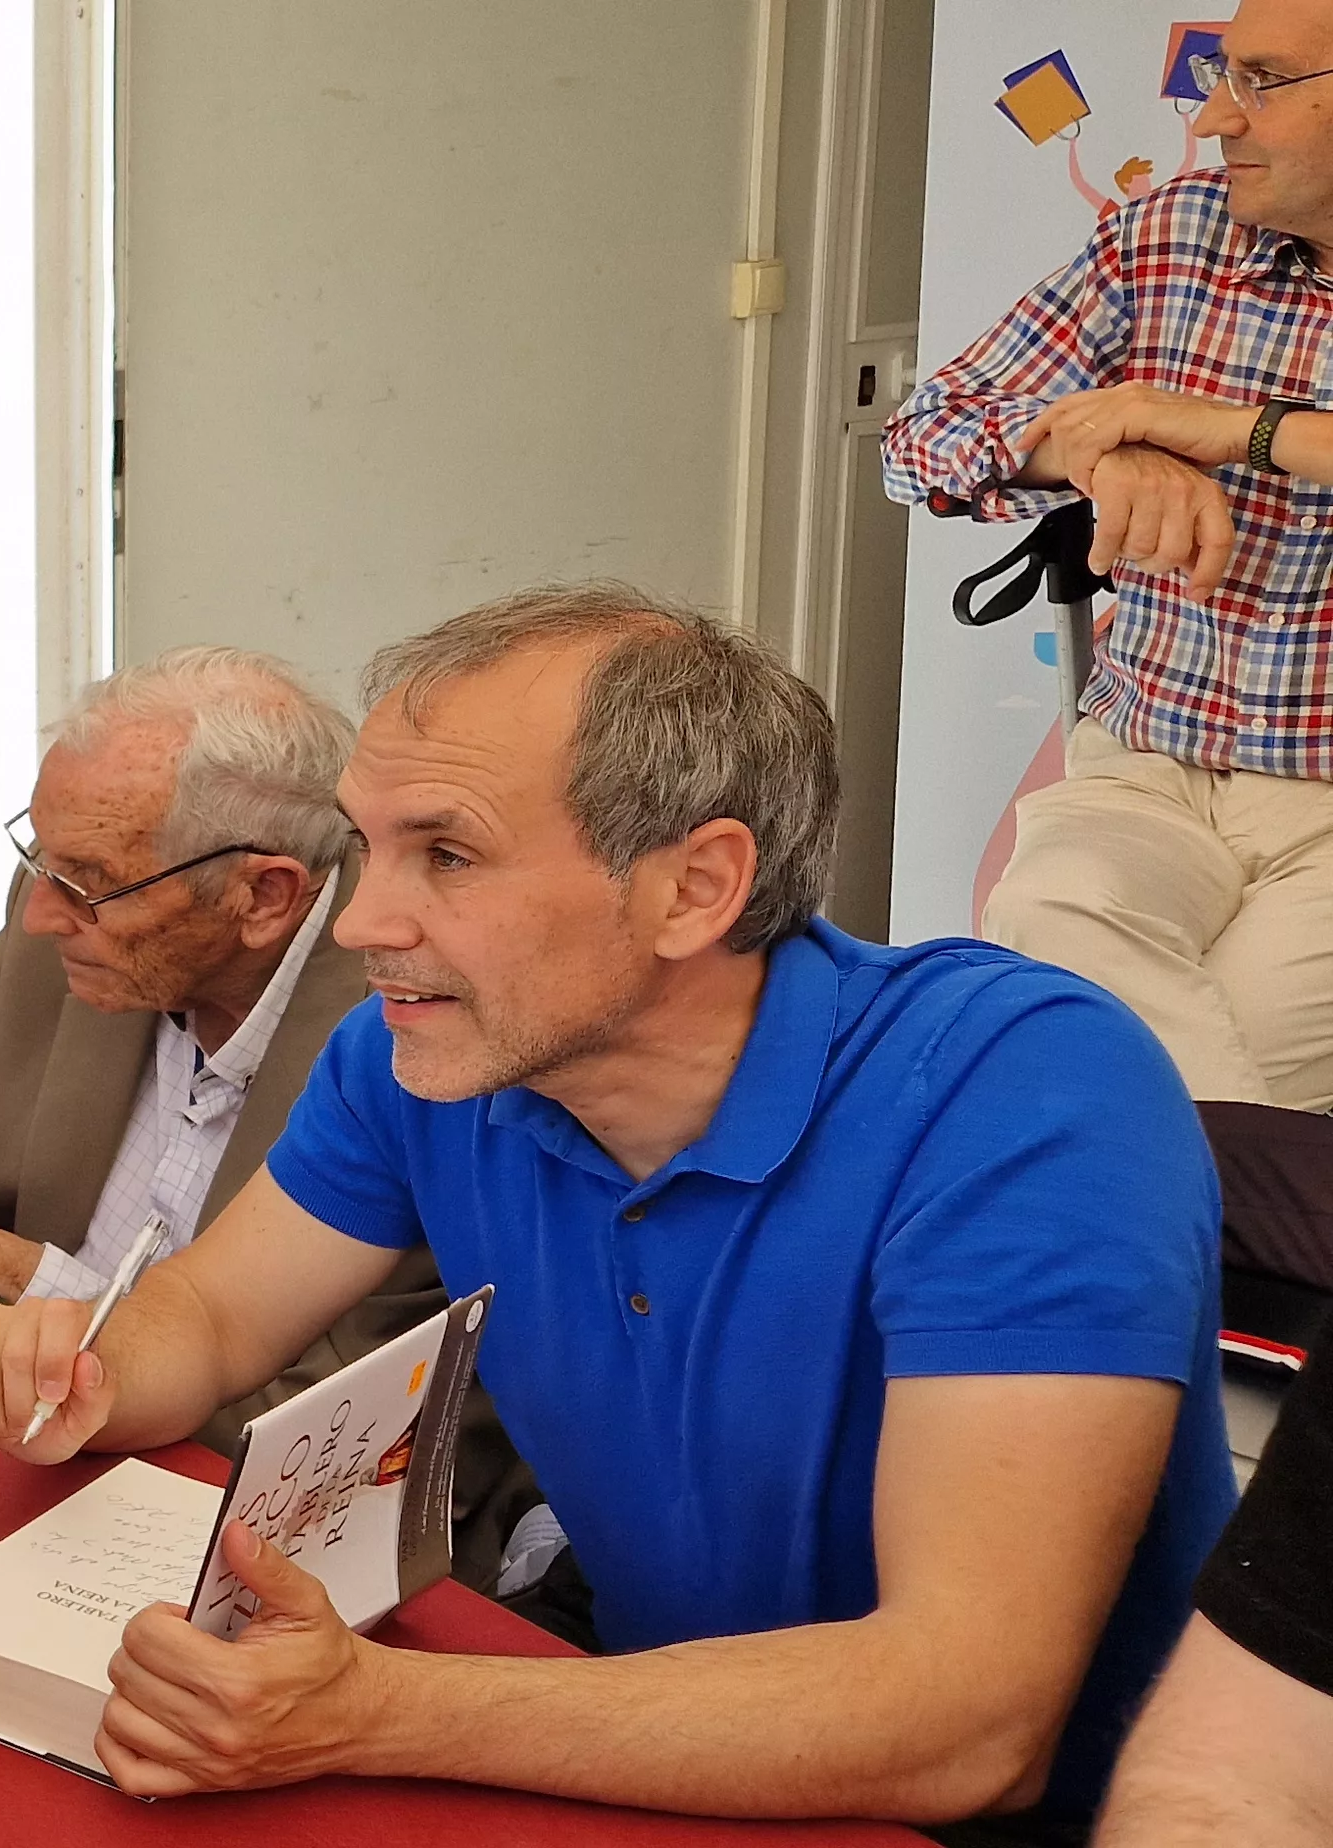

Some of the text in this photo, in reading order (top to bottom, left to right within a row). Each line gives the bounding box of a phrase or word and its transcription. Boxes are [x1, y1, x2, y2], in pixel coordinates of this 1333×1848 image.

[285, 1398, 352, 1559] TABLERO
[324, 1416, 378, 1551] REINA
[36, 1590, 119, 1624] TABLERO
[53, 1579, 110, 1605] REINA
